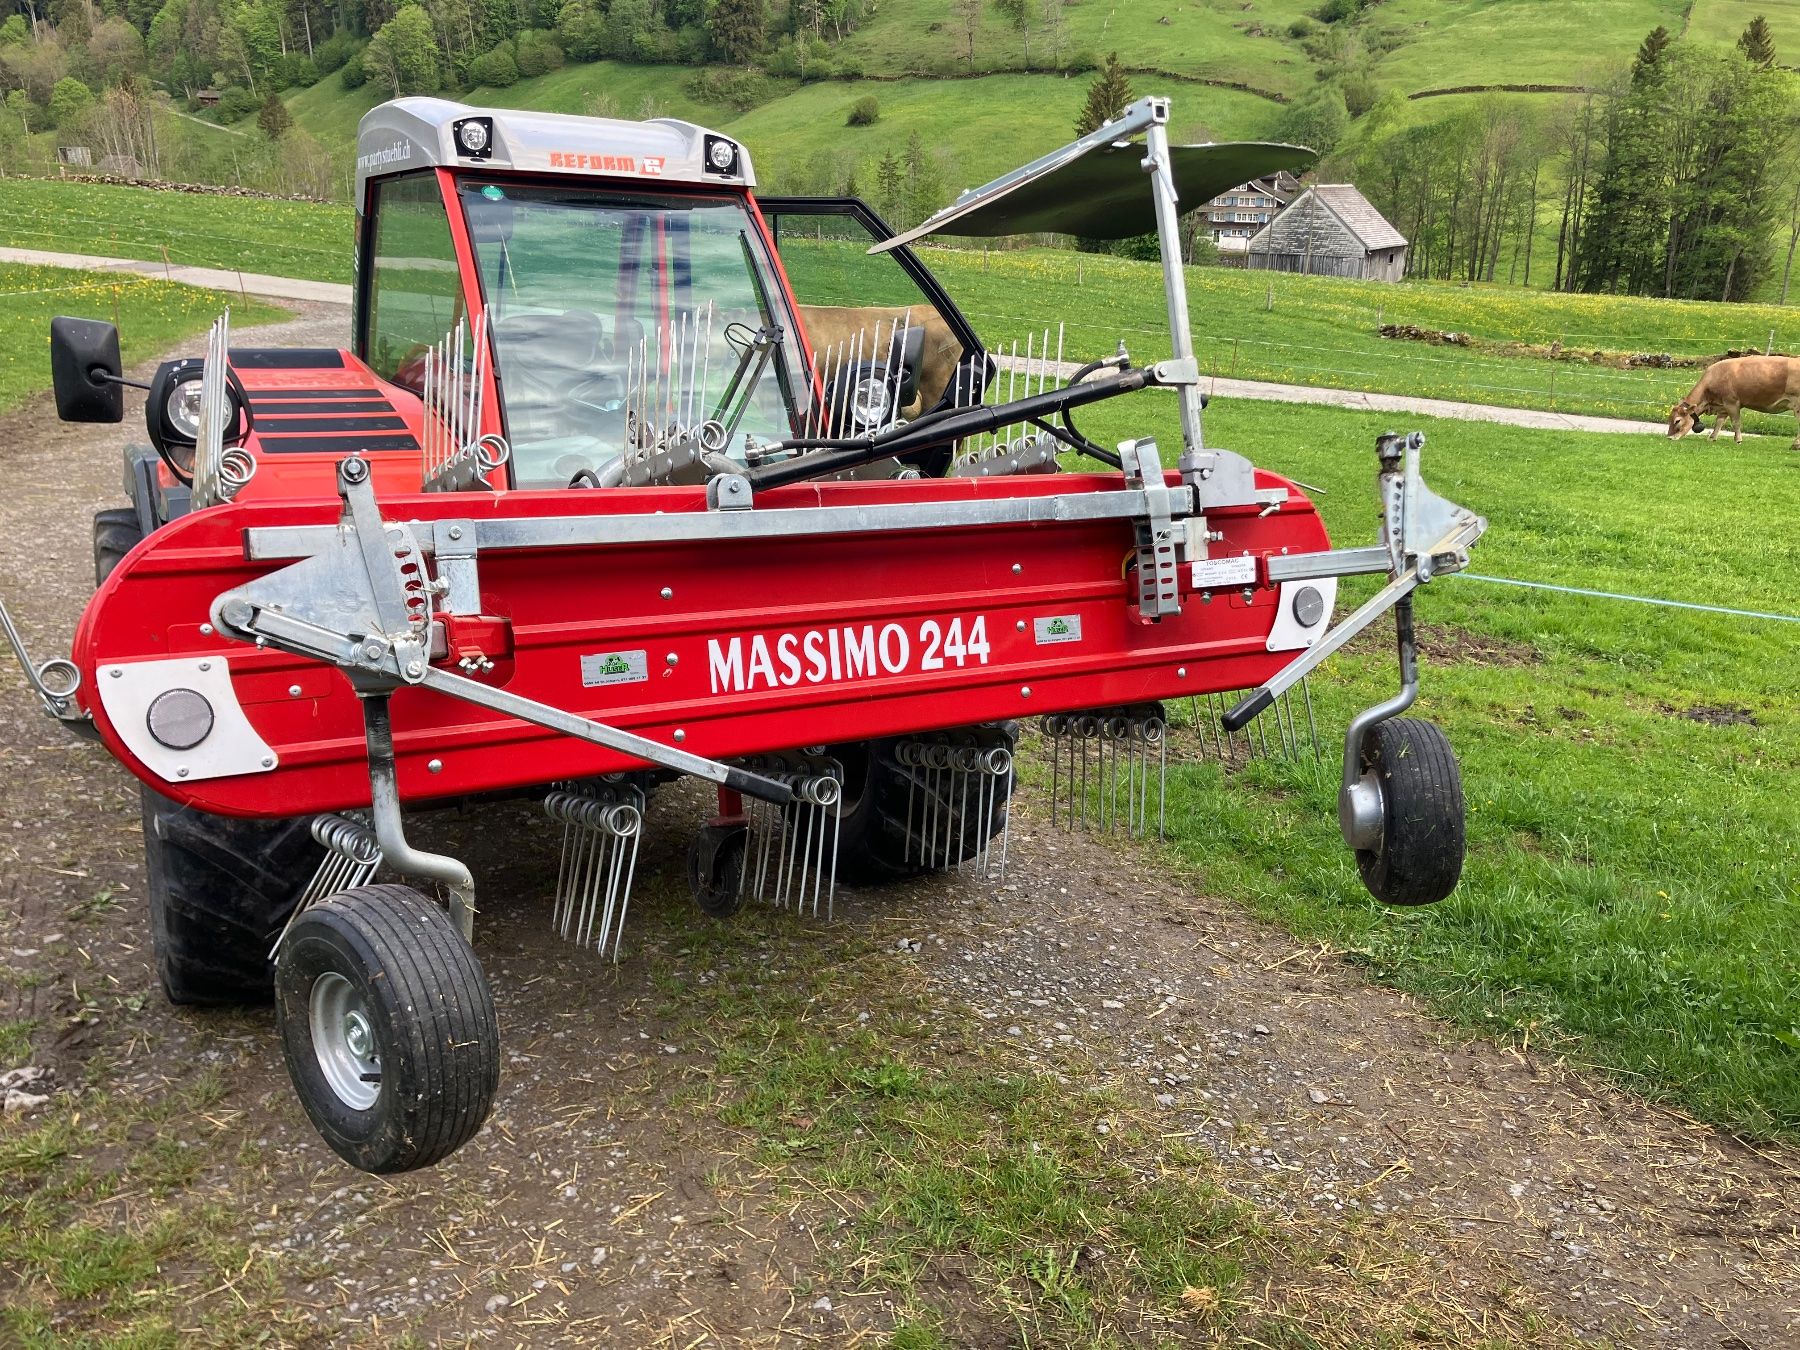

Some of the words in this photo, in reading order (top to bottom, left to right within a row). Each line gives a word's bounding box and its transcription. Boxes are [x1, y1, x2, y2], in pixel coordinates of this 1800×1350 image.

[549, 153, 635, 171] REFORM
[707, 623, 910, 694] MASSIMO
[919, 615, 990, 670] 244
